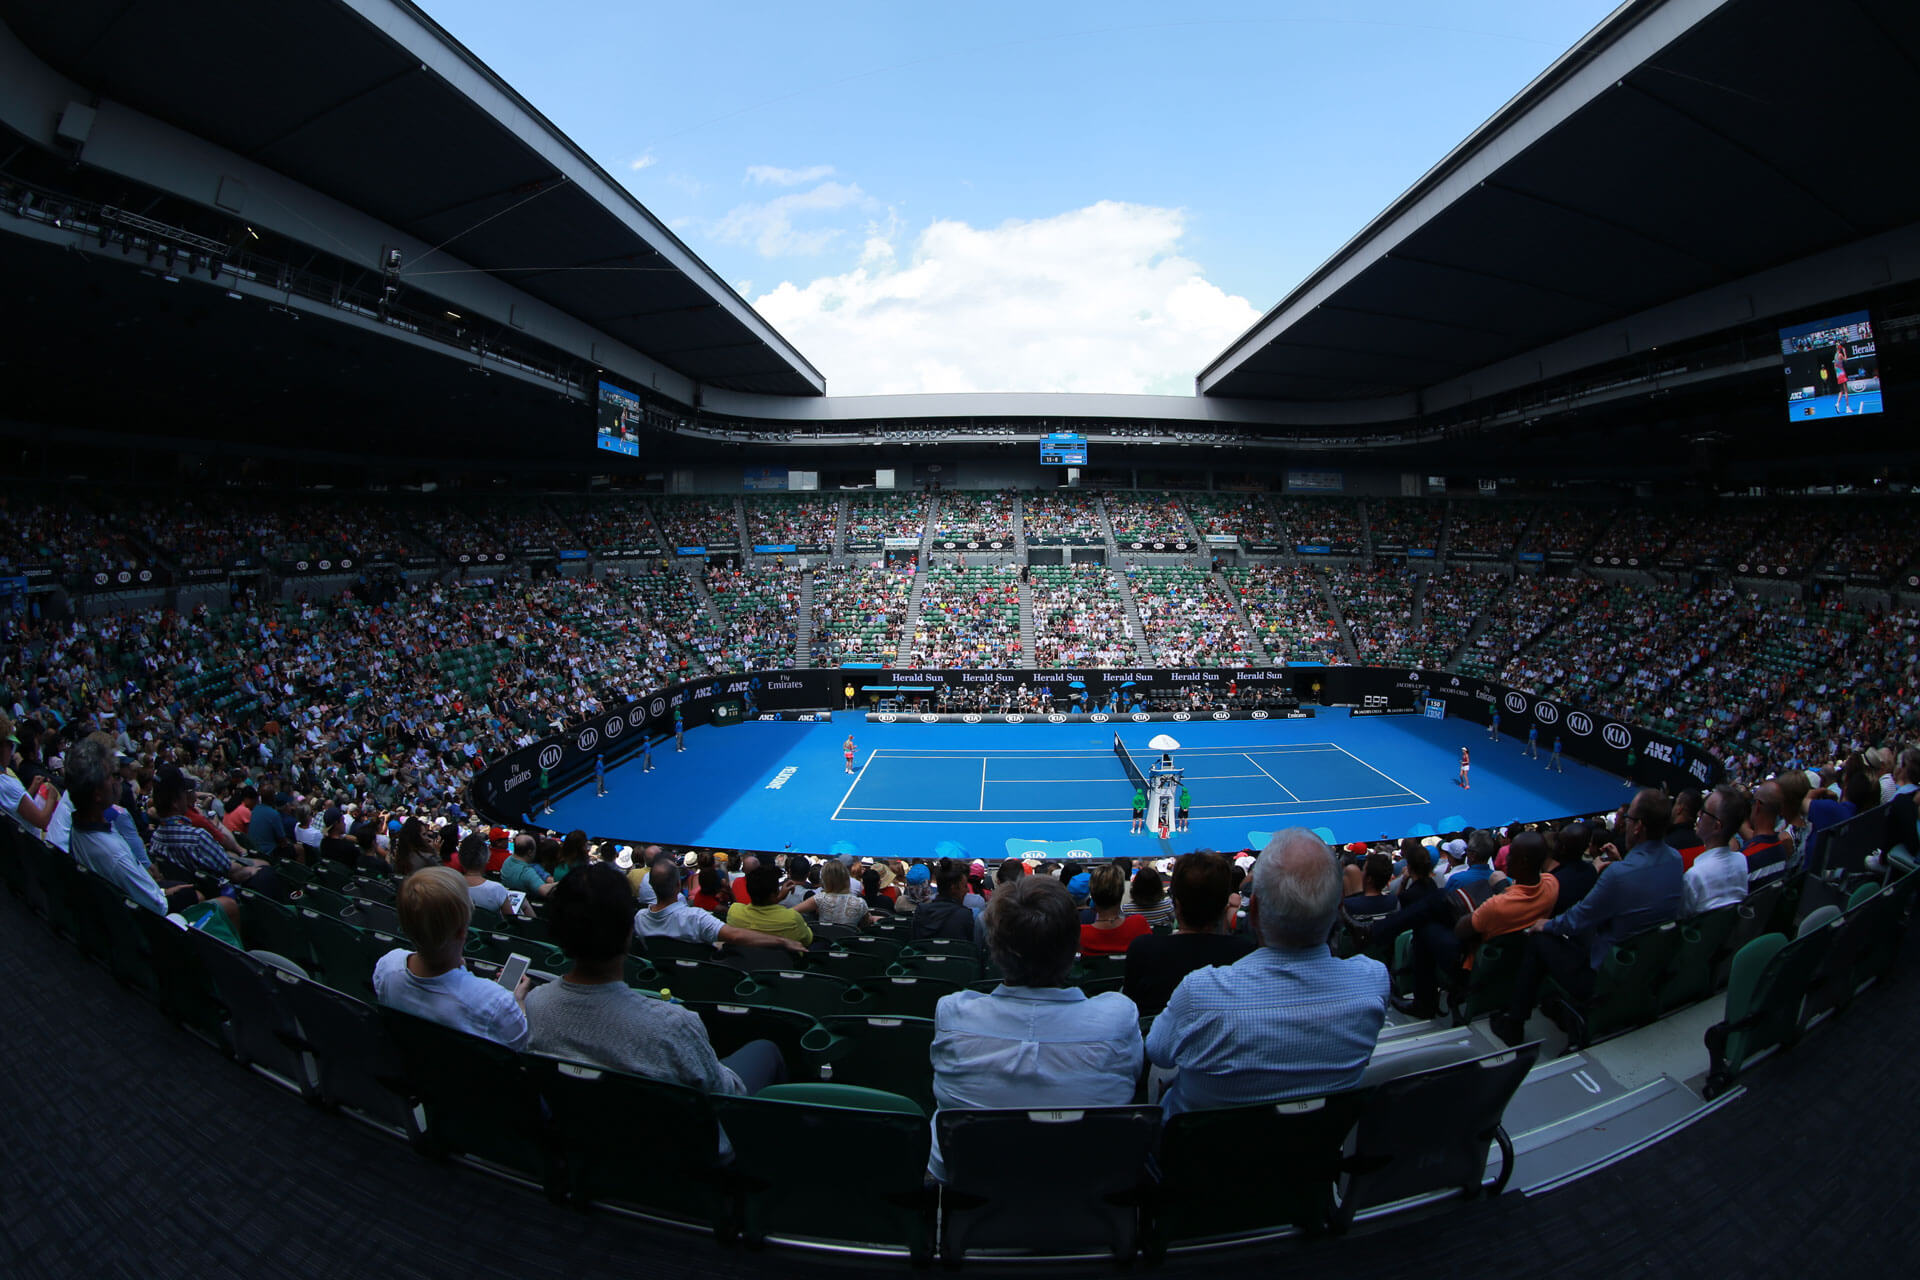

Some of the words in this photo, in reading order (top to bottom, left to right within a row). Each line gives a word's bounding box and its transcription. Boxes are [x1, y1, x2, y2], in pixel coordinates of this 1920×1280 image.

[1852, 342, 1876, 355] Herald
[892, 674, 923, 682] Herald
[962, 674, 994, 682] Herald
[1033, 674, 1064, 682] Herald
[1171, 673, 1200, 681] Herald
[727, 681, 750, 693] ANZ
[768, 681, 803, 690] Emirates
[694, 686, 712, 699] ANZ
[1476, 689, 1497, 704] Emirates
[670, 693, 683, 707] ANZ
[1508, 697, 1523, 710] KIA
[1427, 710, 1441, 719] IBM
[1537, 706, 1554, 720] KIA
[1570, 716, 1589, 732] KIA
[1606, 728, 1626, 745] KIA
[1643, 741, 1673, 763] ANZ
[1688, 758, 1708, 784] ANZ
[504, 769, 532, 792] Emirates
